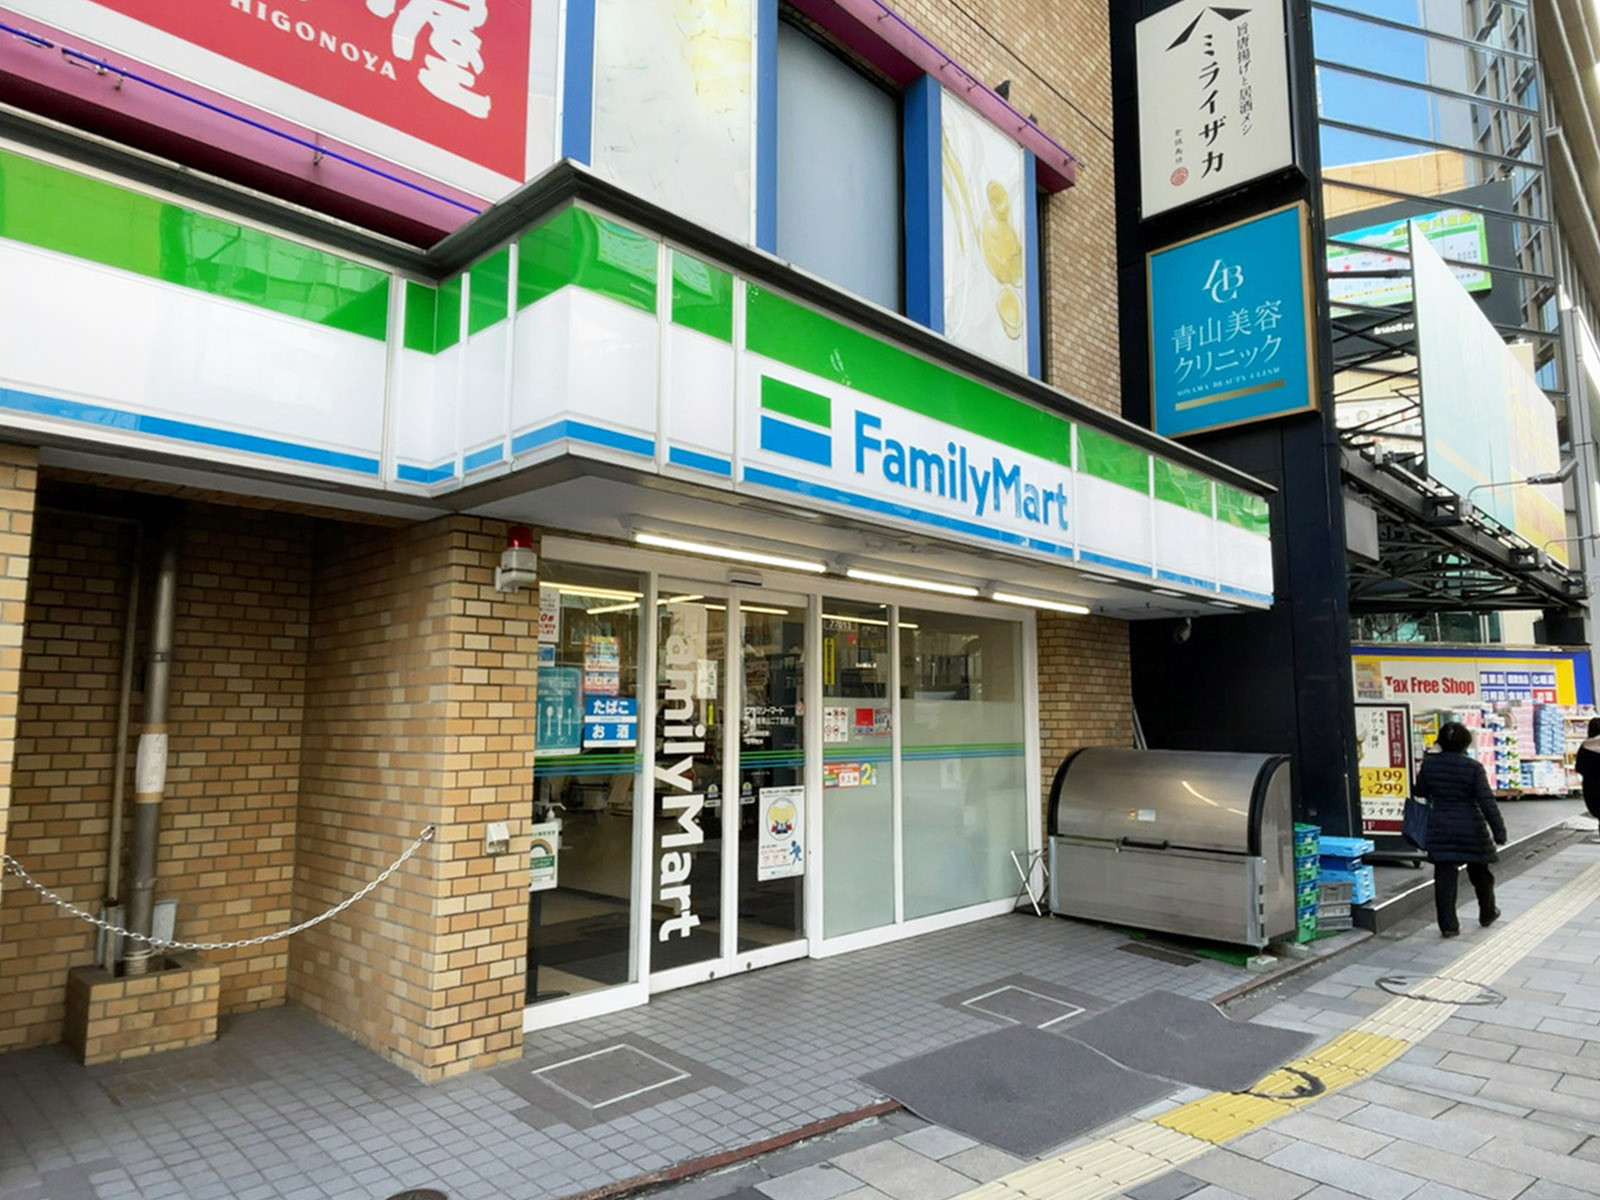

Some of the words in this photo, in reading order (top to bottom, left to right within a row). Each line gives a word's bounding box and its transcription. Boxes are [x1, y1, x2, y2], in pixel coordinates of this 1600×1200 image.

[230, 0, 397, 81] HIGONOYA
[365, 0, 491, 119] 屋
[1198, 33, 1227, 179] ミライザカ
[1170, 299, 1282, 354] 青山美容
[1174, 333, 1282, 384] クリニック
[854, 409, 1069, 531] FamilyMart
[593, 699, 629, 715] たばこ
[1385, 675, 1408, 693] Tax
[1410, 676, 1439, 693] Free
[1442, 676, 1475, 696] Shop
[592, 724, 629, 739] お酒
[654, 606, 705, 943] amilyMart
